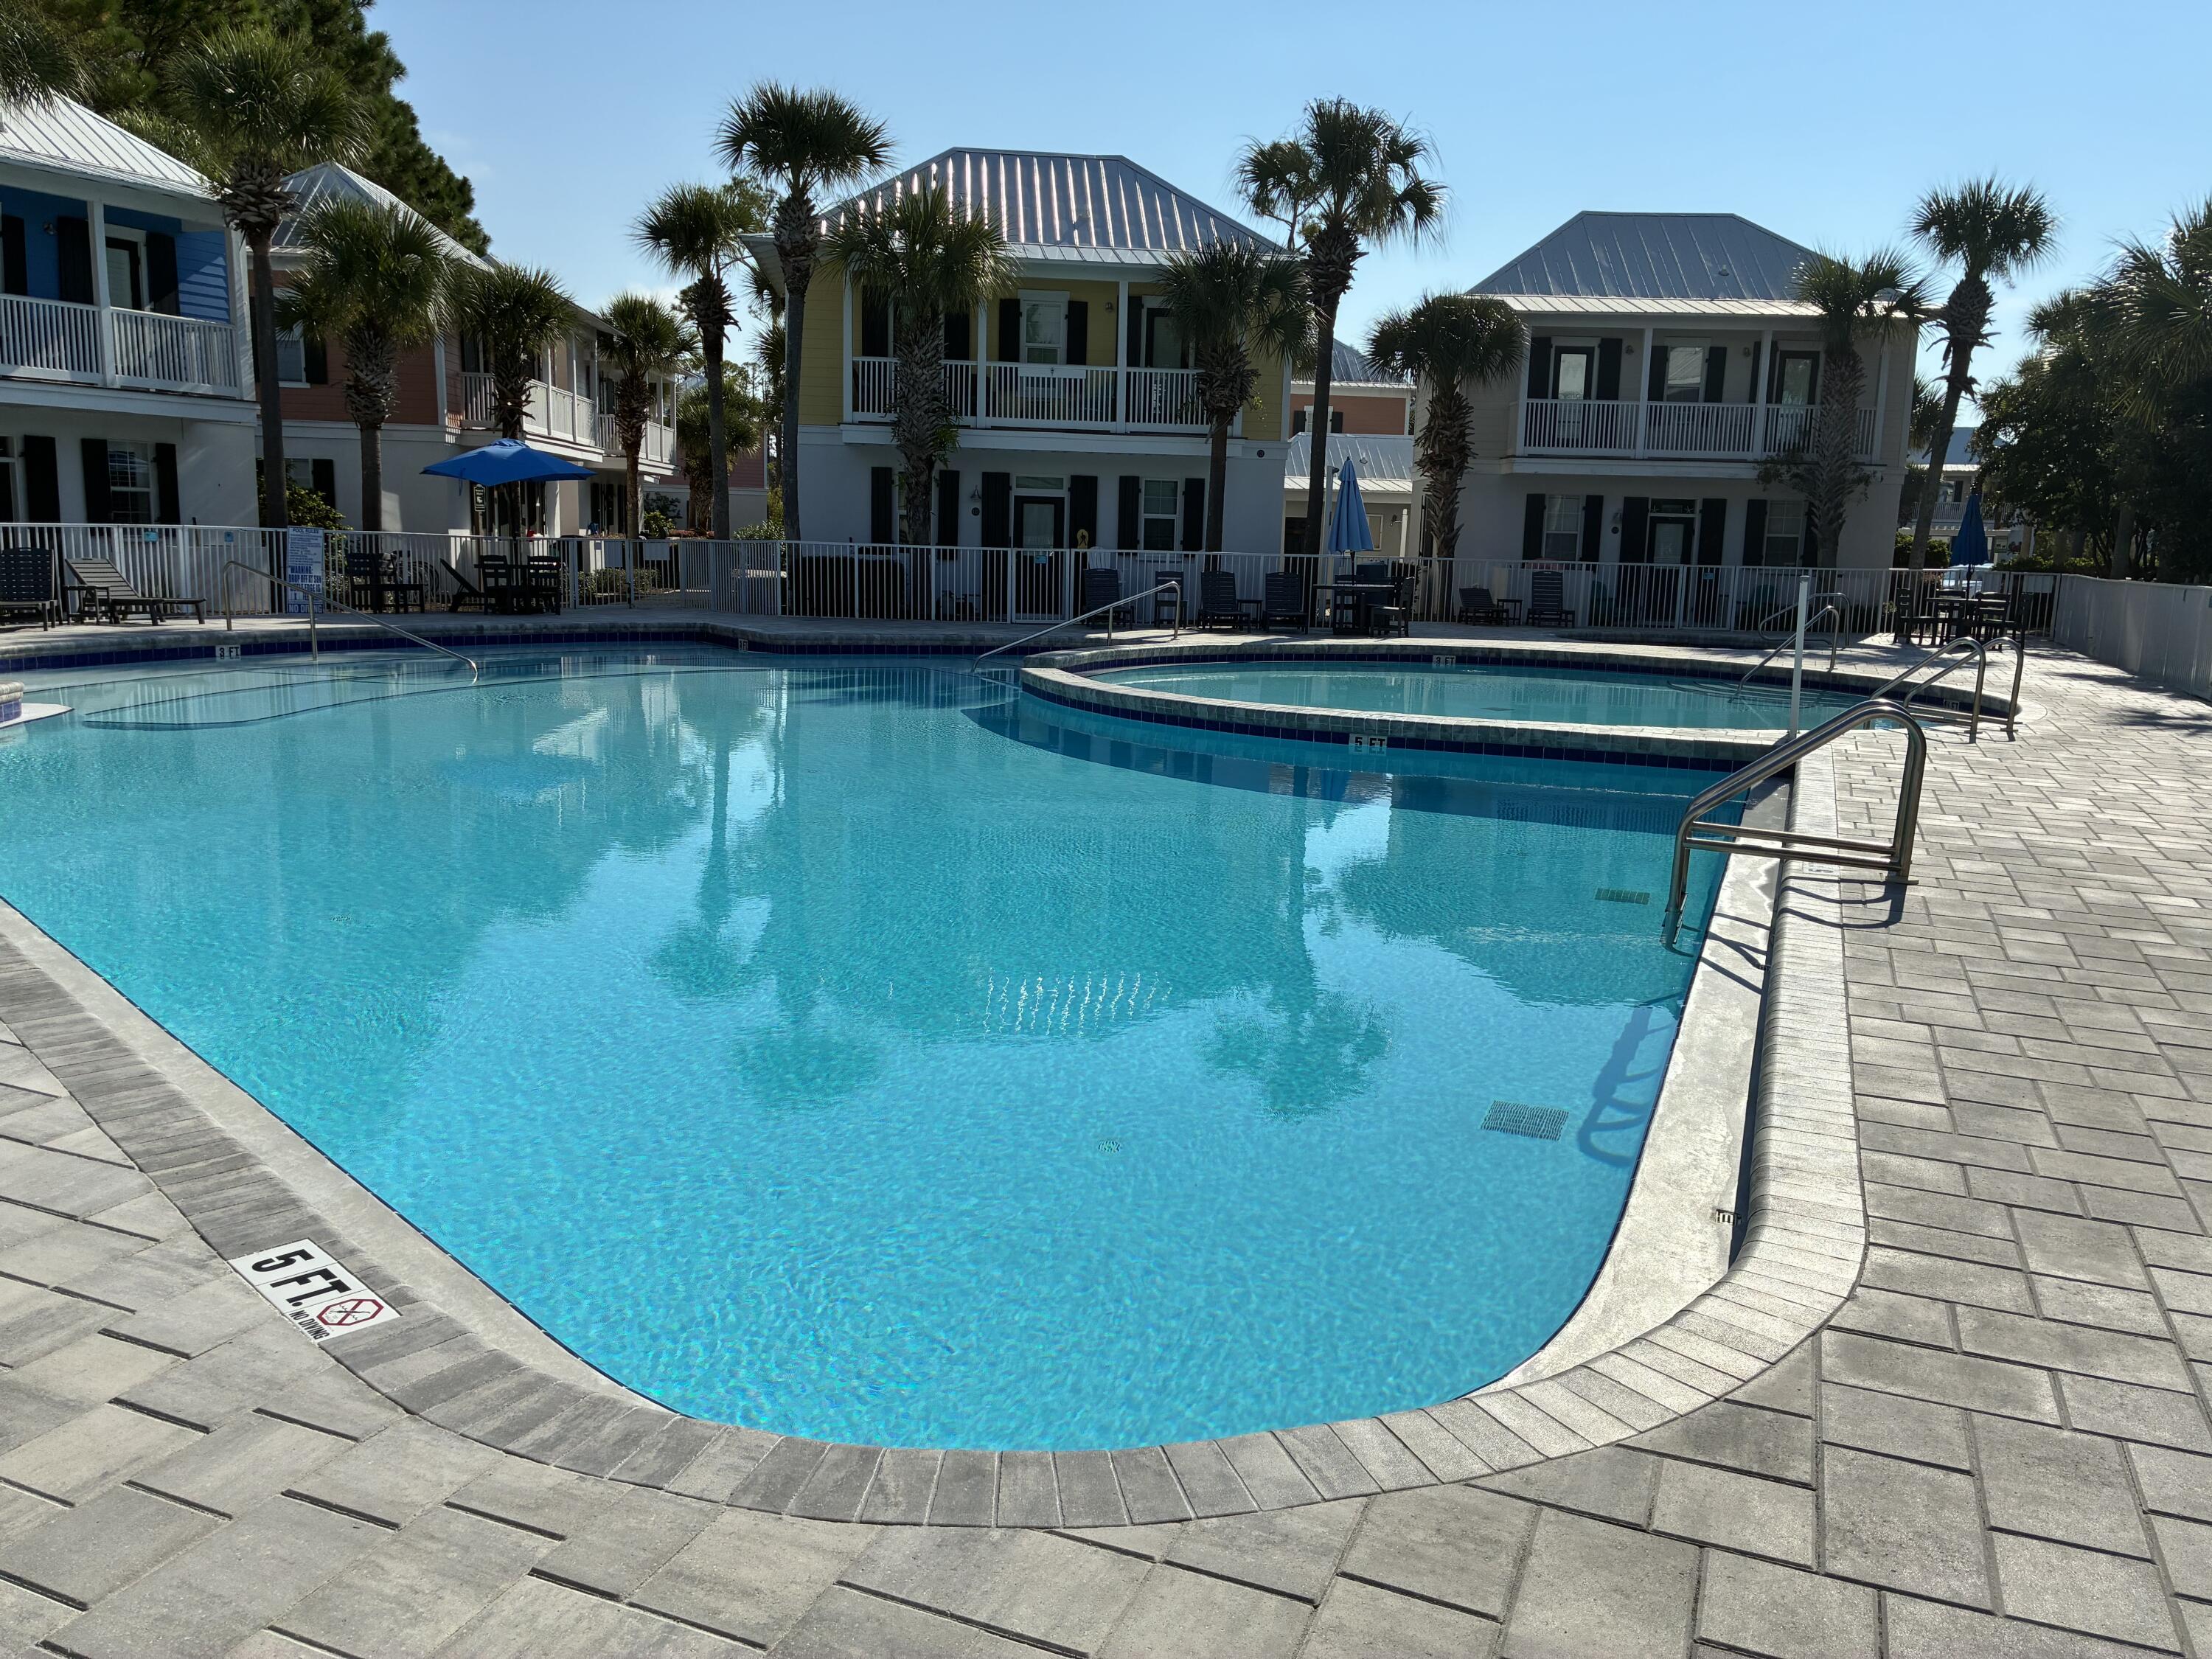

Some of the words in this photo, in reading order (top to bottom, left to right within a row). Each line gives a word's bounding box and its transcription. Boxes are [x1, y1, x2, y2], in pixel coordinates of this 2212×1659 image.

[289, 604, 299, 613] NO
[219, 647, 225, 657] 3
[1354, 736, 1363, 745] 5
[251, 1248, 316, 1272] 5
[269, 1267, 352, 1307] FT.
[288, 1310, 310, 1321] NO
[297, 1318, 330, 1340] DIVING
